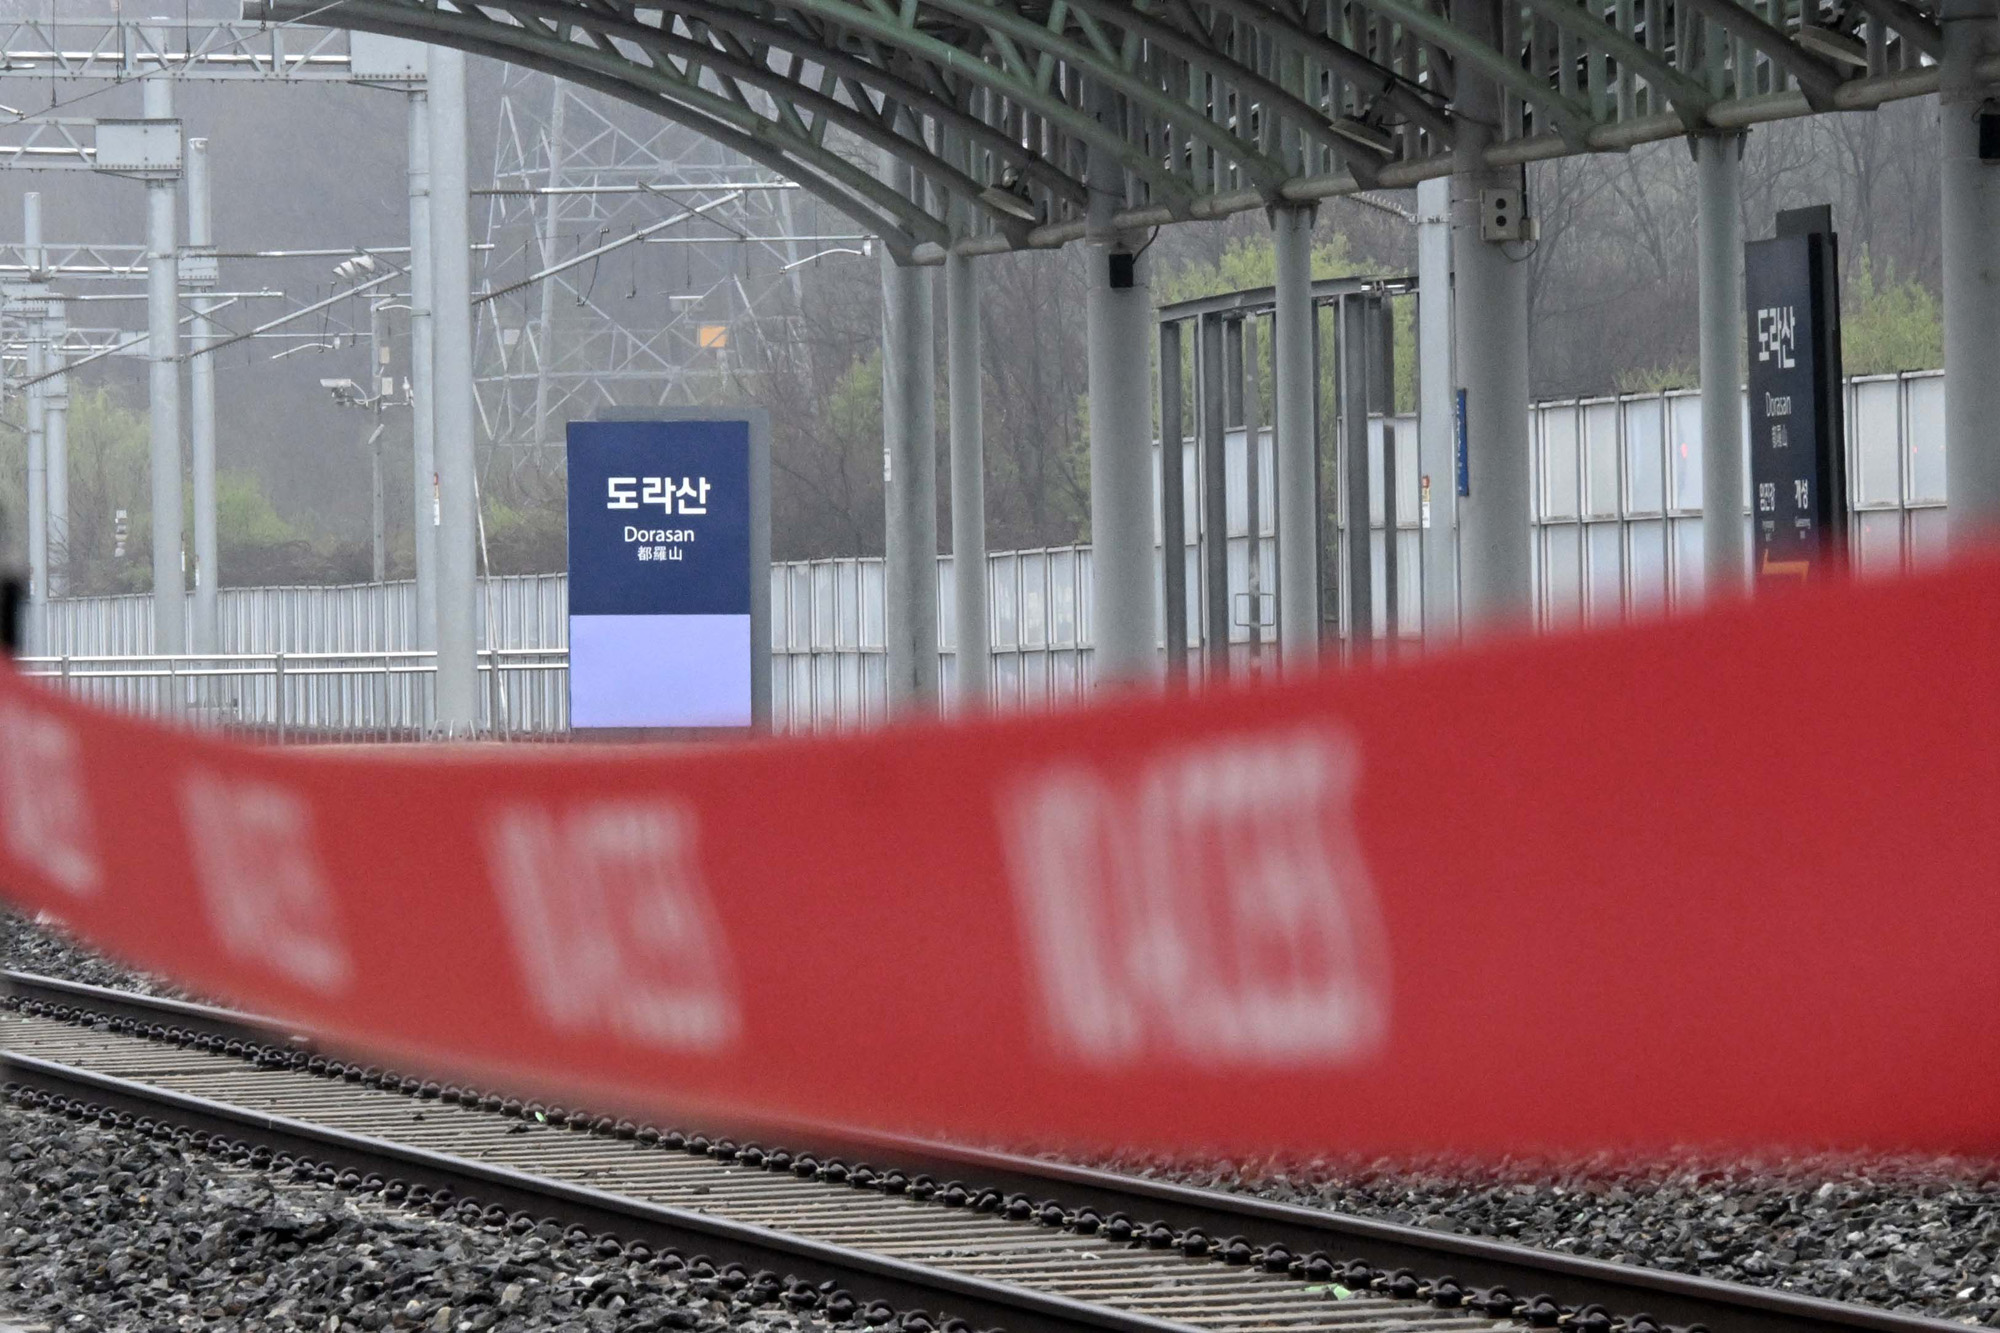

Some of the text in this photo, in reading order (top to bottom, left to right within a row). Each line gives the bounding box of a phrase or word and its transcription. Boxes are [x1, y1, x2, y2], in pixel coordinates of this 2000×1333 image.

[1757, 306, 1796, 369] 도라산
[1765, 391, 1792, 417] Dorasan
[607, 477, 711, 515] 도라산
[1759, 482, 1776, 512] 임진강
[1794, 479, 1808, 510] 개성
[624, 525, 695, 542] Dorasan
[637, 545, 683, 561] 都羅山
